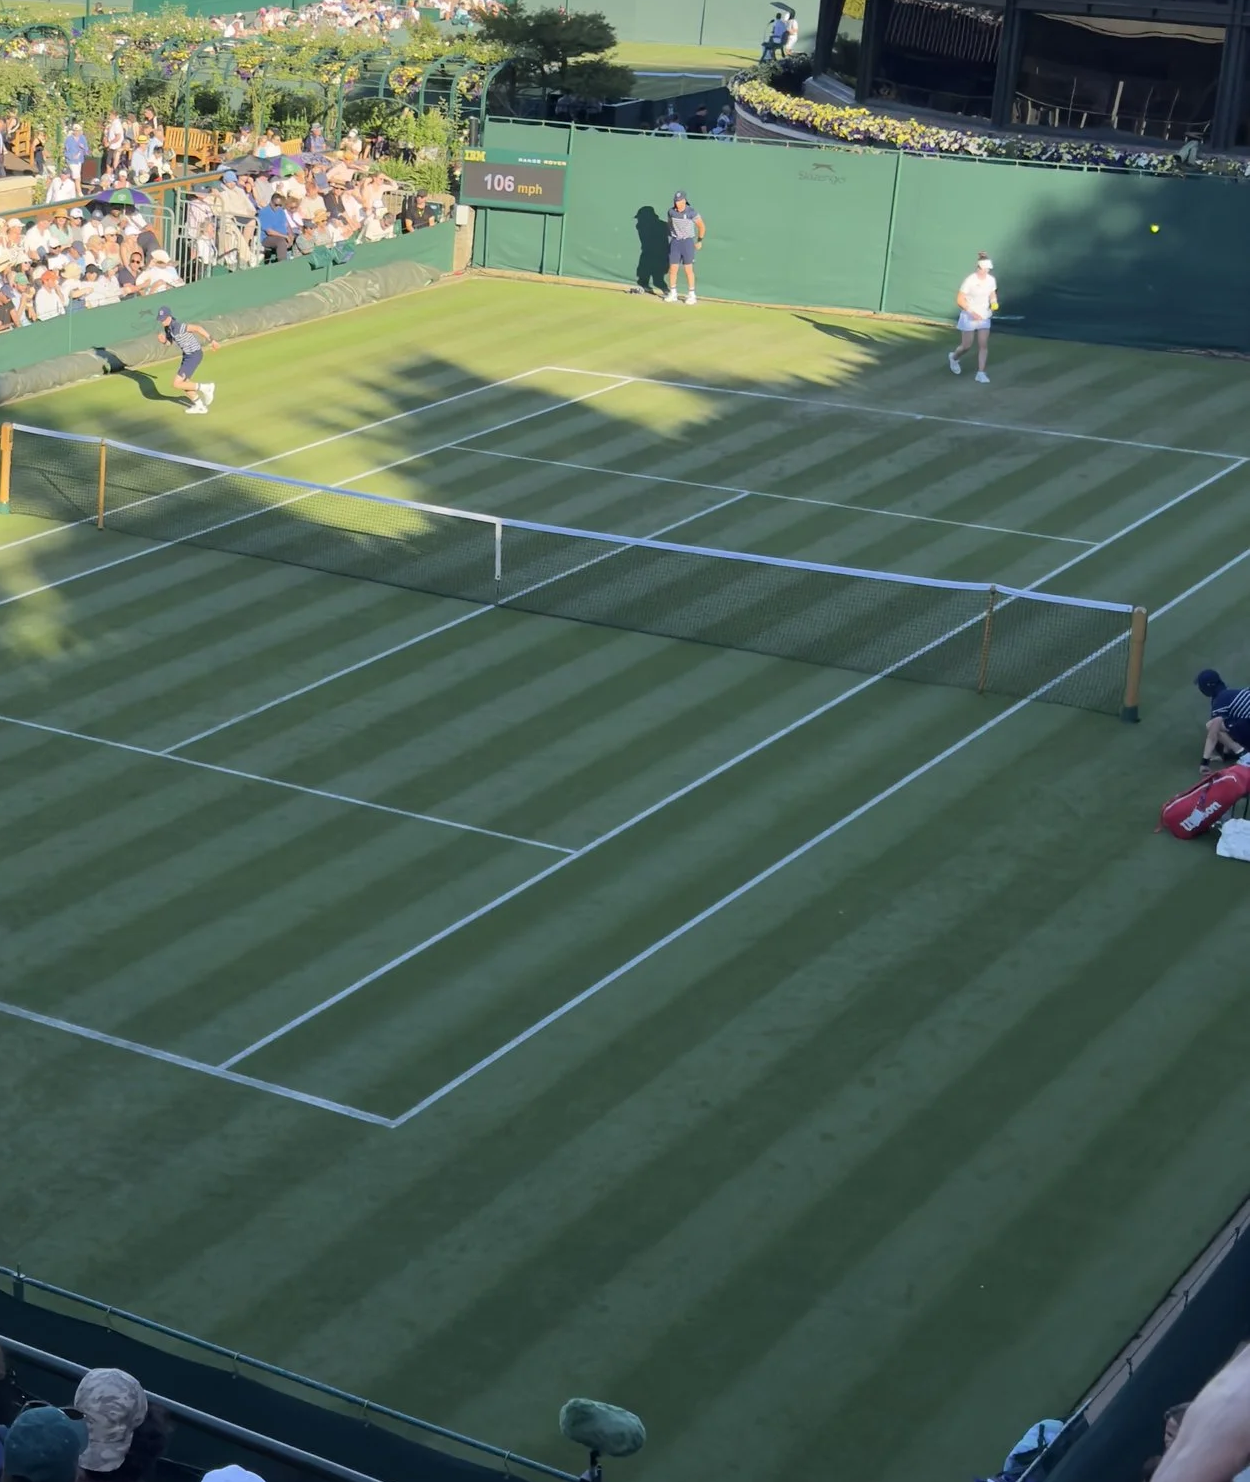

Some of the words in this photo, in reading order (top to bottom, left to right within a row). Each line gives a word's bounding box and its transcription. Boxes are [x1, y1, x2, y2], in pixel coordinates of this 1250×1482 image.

[464, 149, 486, 162] IBM
[484, 173, 515, 192] 106
[517, 183, 543, 196] mph
